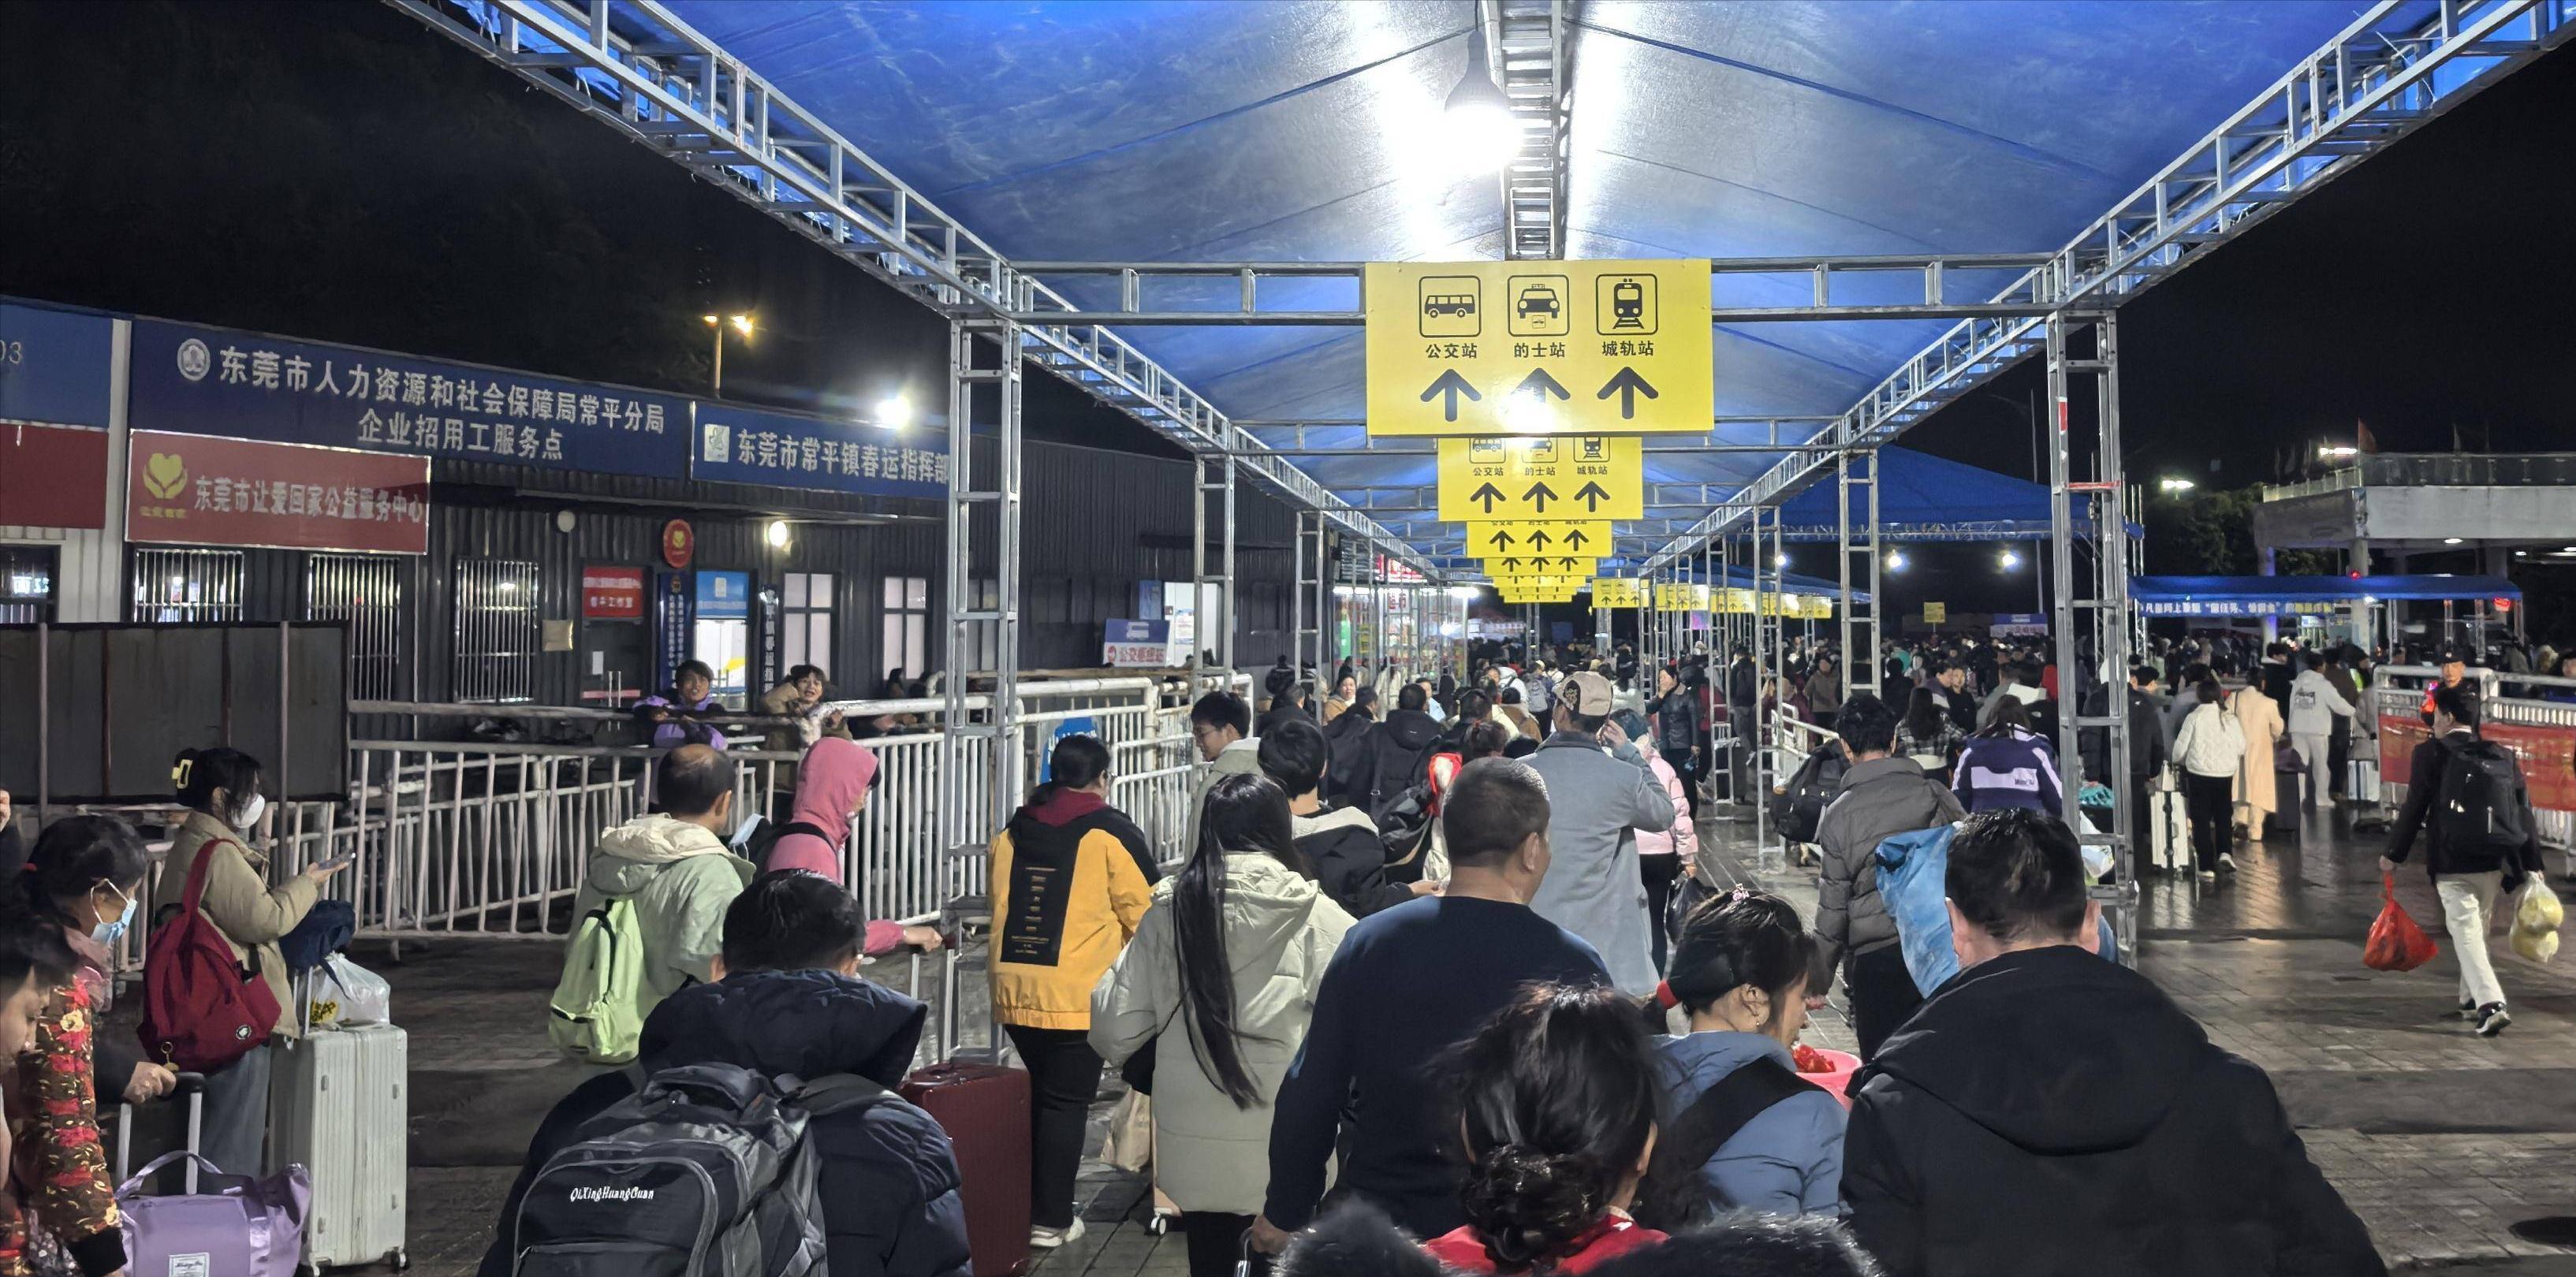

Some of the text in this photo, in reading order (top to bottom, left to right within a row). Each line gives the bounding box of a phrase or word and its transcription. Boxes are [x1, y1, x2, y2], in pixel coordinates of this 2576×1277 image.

[1425, 341, 1654, 359] 公交站 的士站 城轨站
[219, 344, 664, 434] 东莞市人力资源和社会保障局常平分局
[357, 408, 563, 461] 企业招用工服务点
[737, 428, 949, 484] 东莞市常平镇春运指挥部
[1473, 465, 1608, 476] 公交站 的士站 城轨站
[194, 475, 423, 523] 东莞市让爱回家公益服务中心
